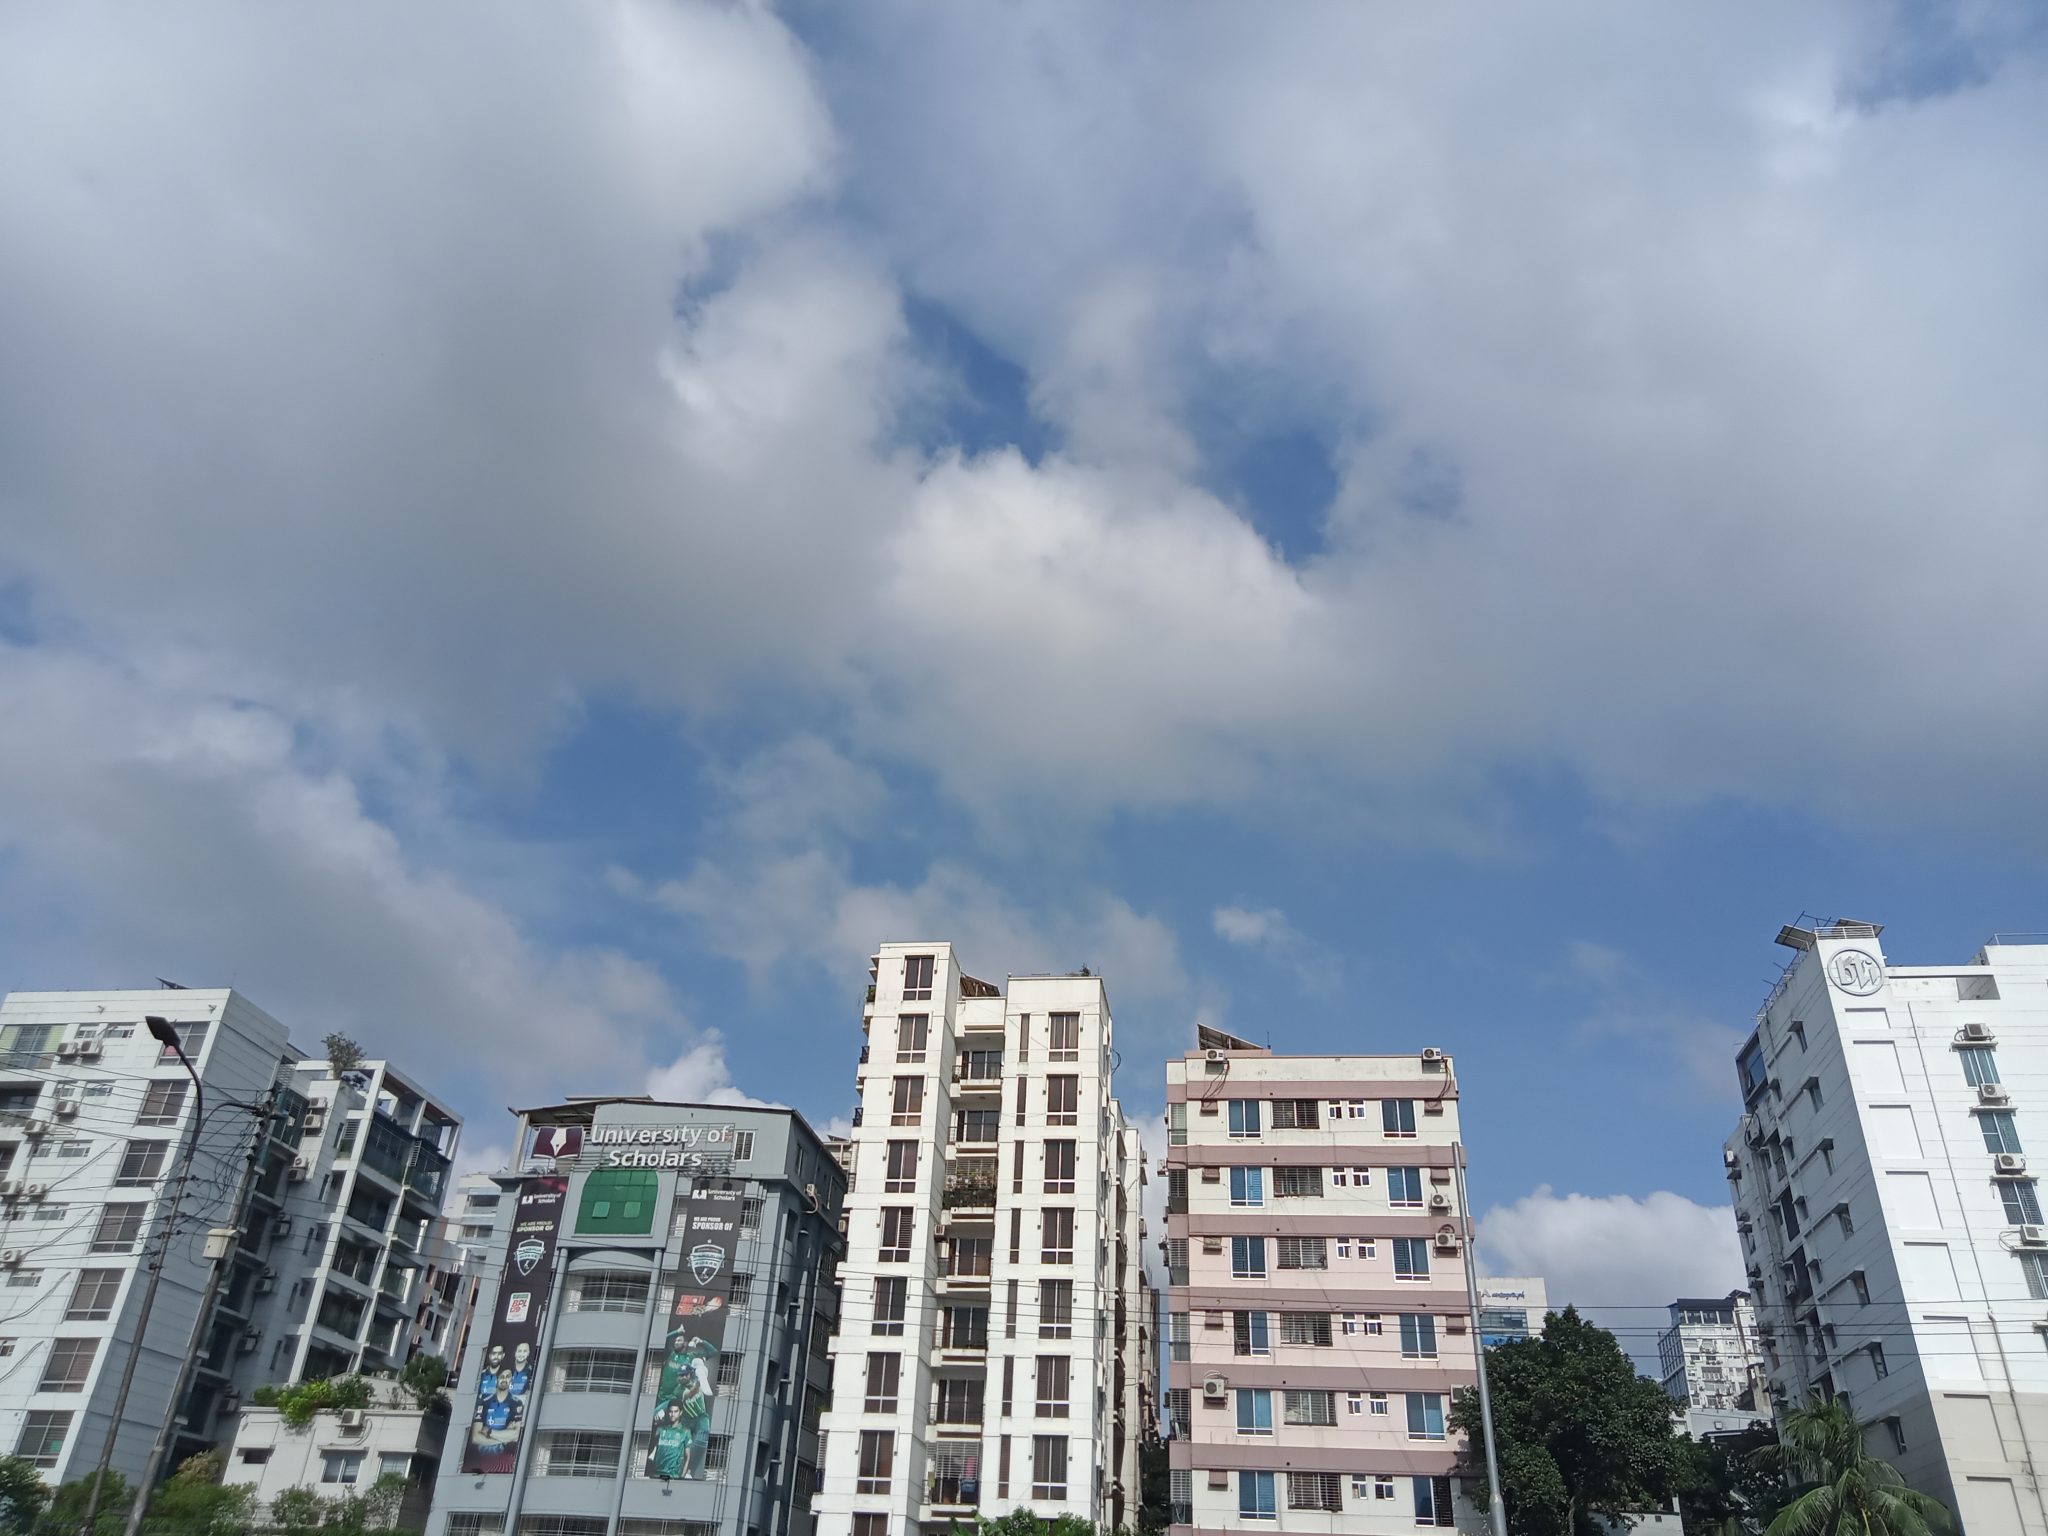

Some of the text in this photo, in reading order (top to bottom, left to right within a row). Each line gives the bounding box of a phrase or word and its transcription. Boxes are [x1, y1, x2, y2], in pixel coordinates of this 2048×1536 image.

[591, 1124, 730, 1147] University of
[608, 1149, 702, 1167] Scholars
[692, 1222, 733, 1231] SPONSOR OF
